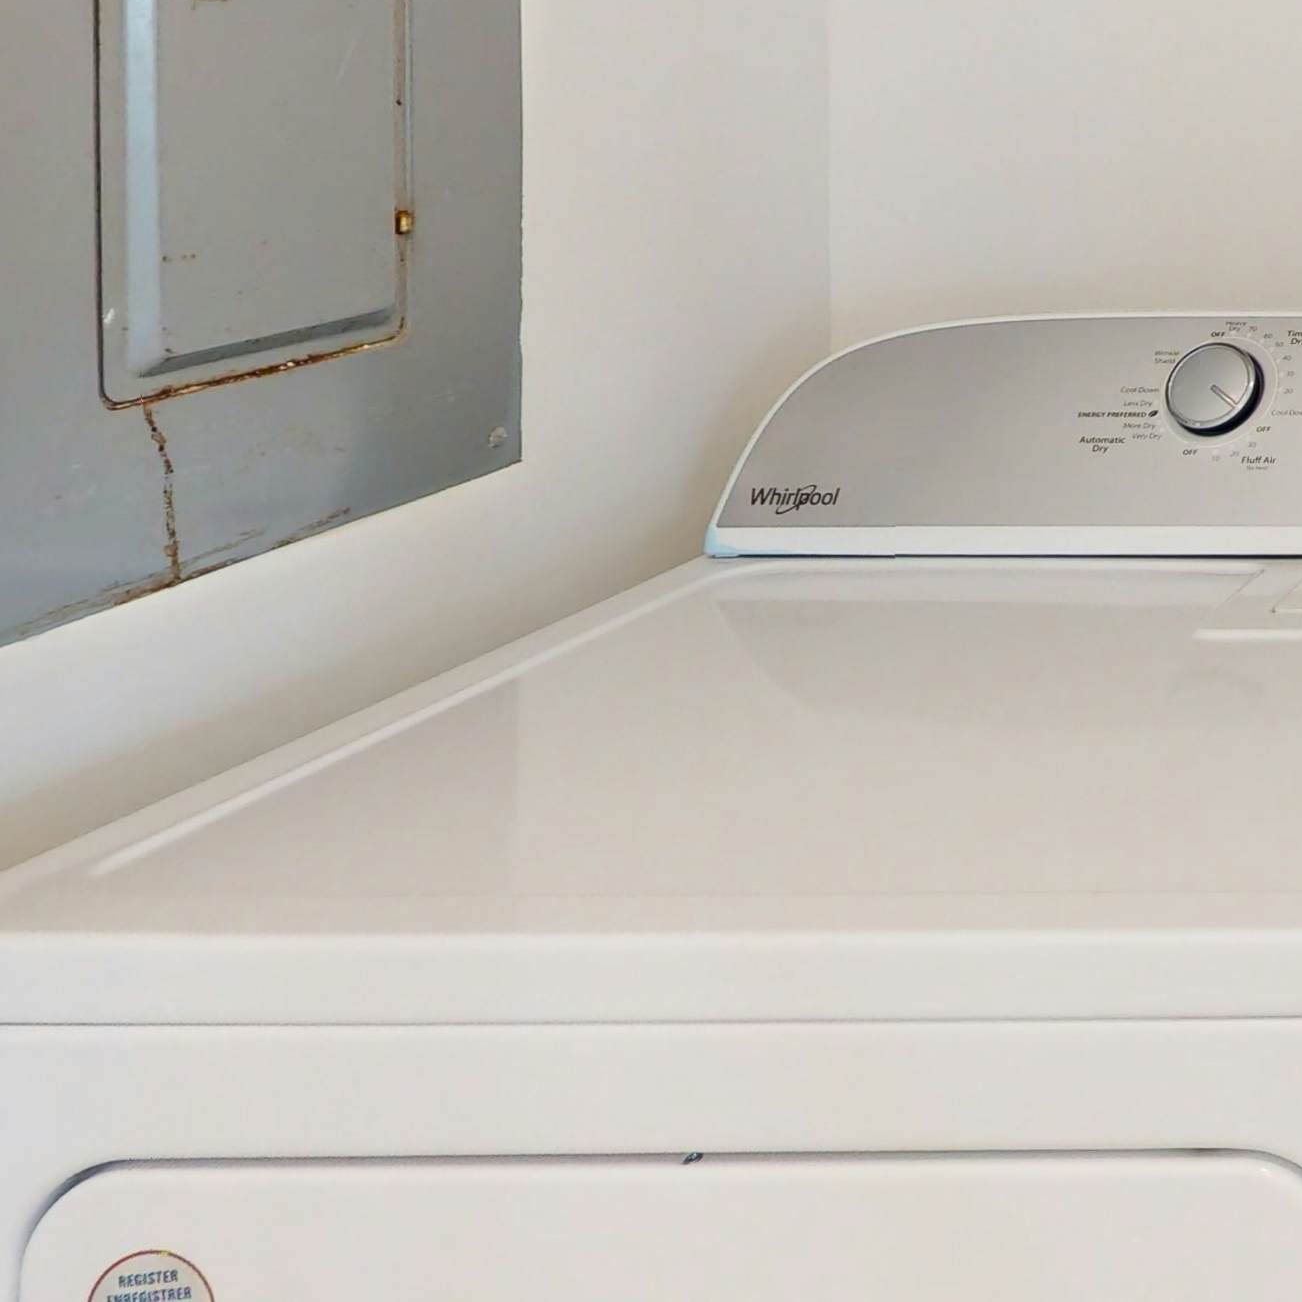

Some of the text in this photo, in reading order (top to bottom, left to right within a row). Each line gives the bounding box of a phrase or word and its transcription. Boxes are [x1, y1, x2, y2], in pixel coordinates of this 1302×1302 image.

[1139, 400, 1153, 408] Dry
[1140, 423, 1156, 431] Dry
[1079, 436, 1126, 445] Automatic
[1148, 433, 1162, 441] Dry
[1092, 444, 1109, 454] Dry
[1241, 456, 1276, 465] Fluff Air
[751, 485, 840, 514] Whirlpool
[118, 1269, 179, 1288] REGISTER
